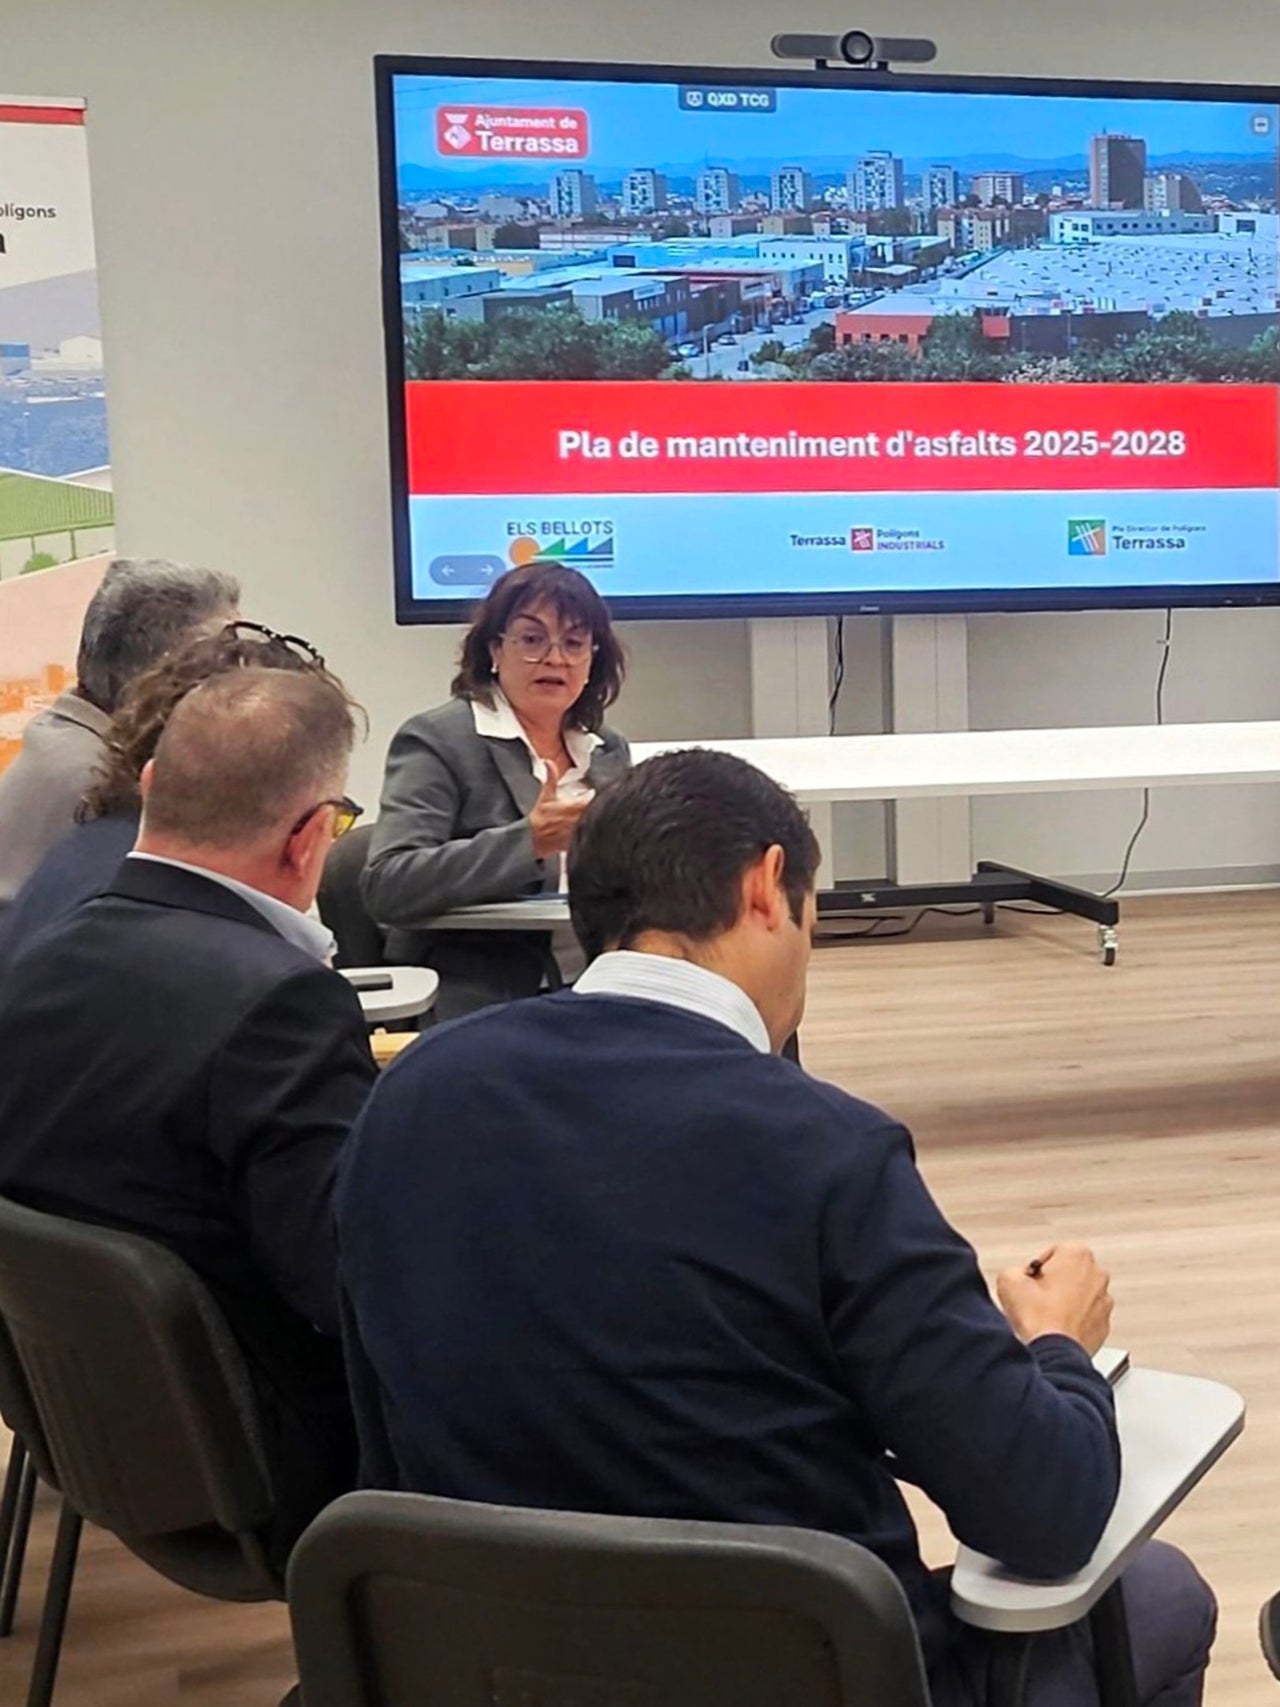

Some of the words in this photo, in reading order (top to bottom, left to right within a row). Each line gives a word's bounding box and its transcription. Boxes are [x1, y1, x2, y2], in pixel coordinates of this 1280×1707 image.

[707, 93, 737, 106] QXD
[740, 93, 770, 107] TCG
[474, 114, 556, 129] Ajuntament
[559, 116, 579, 129] de
[475, 130, 580, 153] Terrassa
[0, 203, 56, 221] lígons
[558, 430, 611, 458] Pla
[618, 430, 659, 458] de
[666, 430, 880, 458] manteniment
[886, 430, 1017, 456] d'asfalts
[1023, 430, 1187, 456] 2025-2028
[507, 521, 537, 536] ELS
[541, 520, 614, 535] BELLOTS
[790, 534, 847, 546] Terrassa
[877, 540, 945, 550] INDUSTRIALS
[1112, 535, 1186, 549] Terrassa
